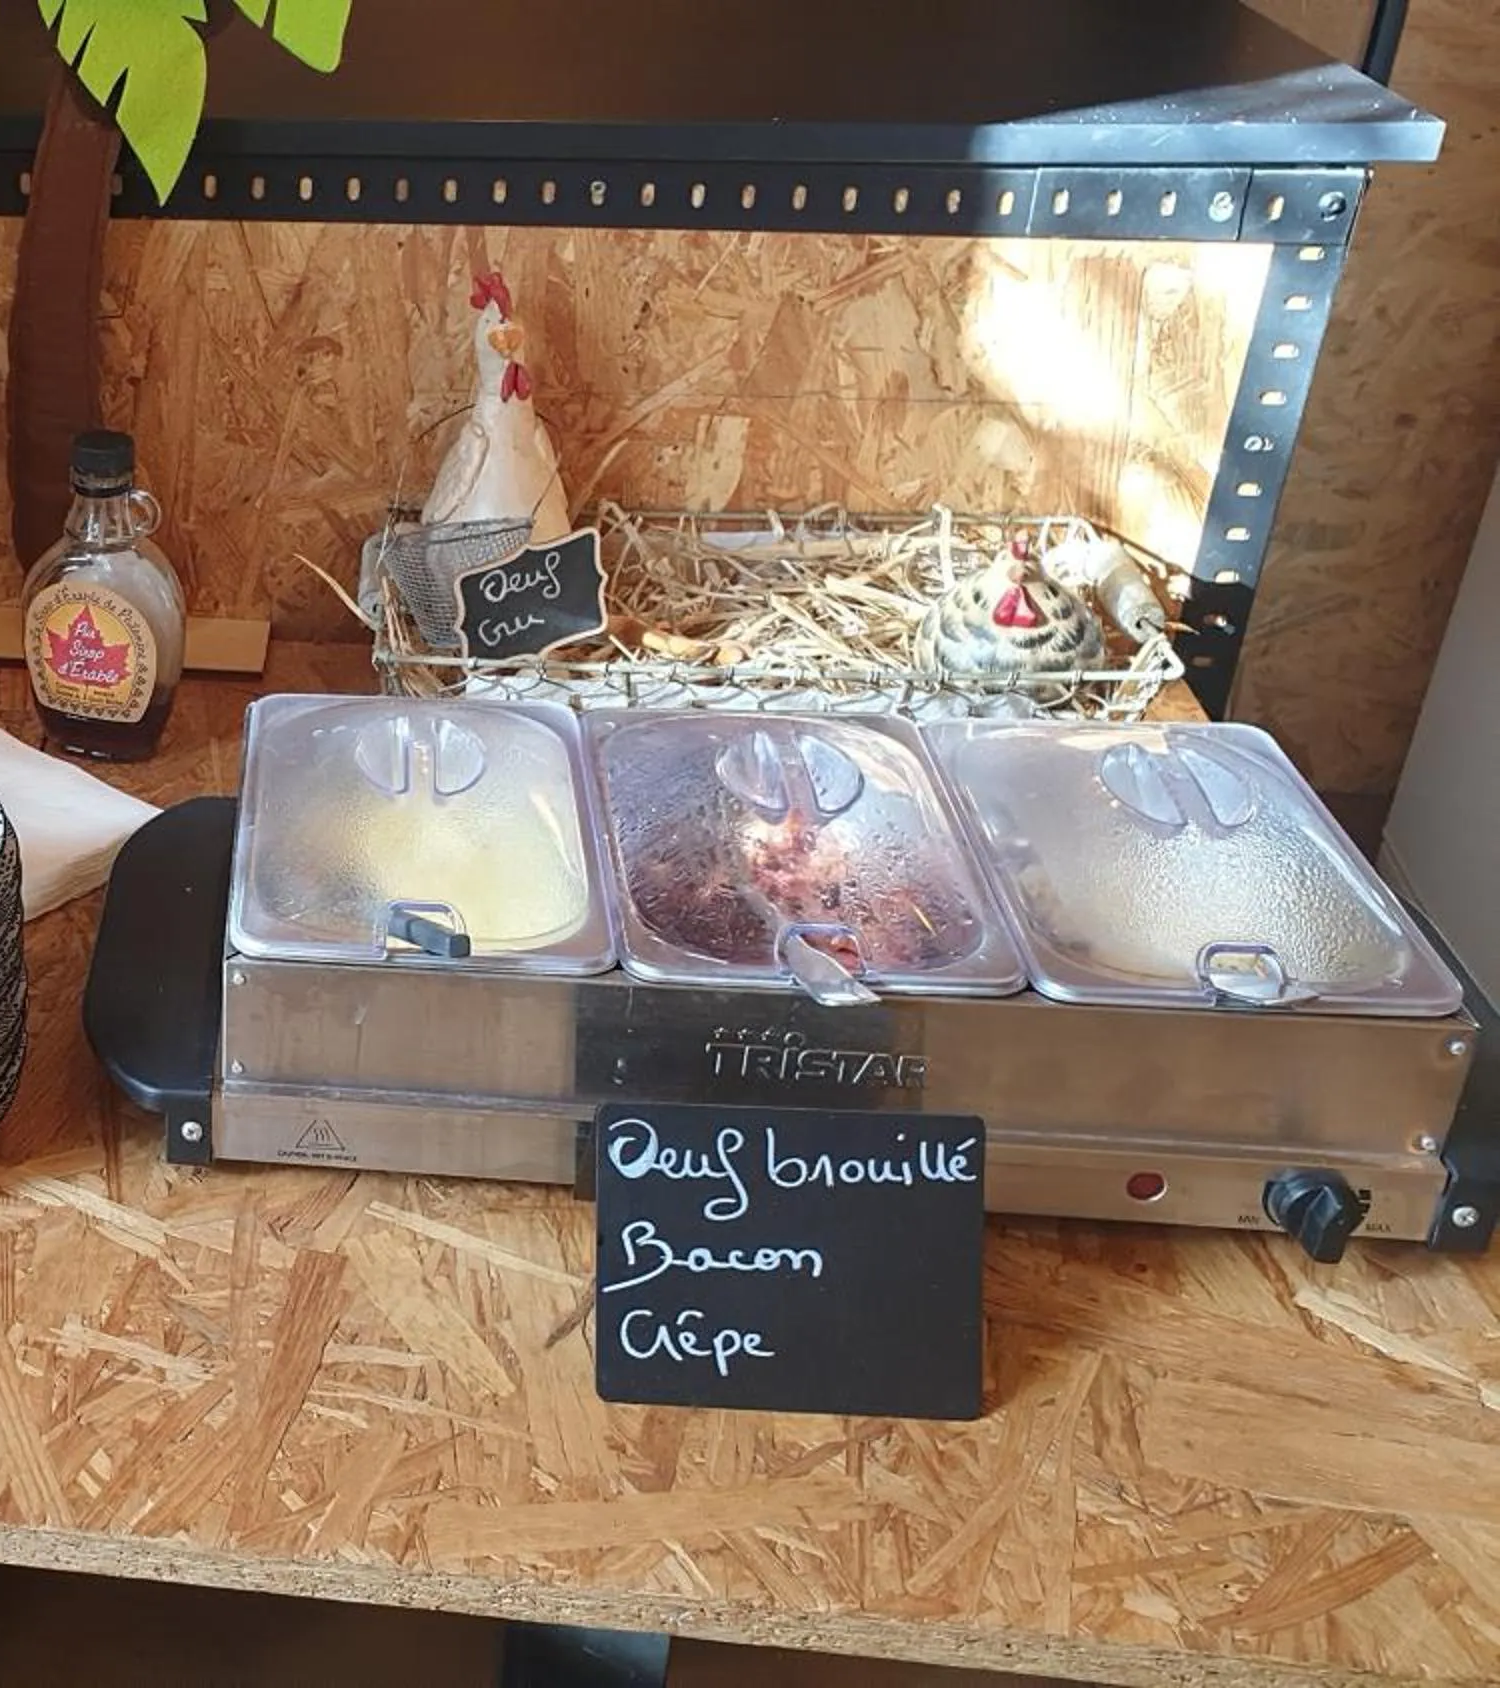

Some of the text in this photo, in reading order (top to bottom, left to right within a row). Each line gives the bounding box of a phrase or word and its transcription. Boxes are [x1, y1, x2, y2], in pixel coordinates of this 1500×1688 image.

[477, 613, 546, 647] Cru
[606, 1118, 978, 1222] Oeuf brouillé
[601, 1221, 824, 1294] Bacon
[619, 1309, 776, 1377] Crêpe
